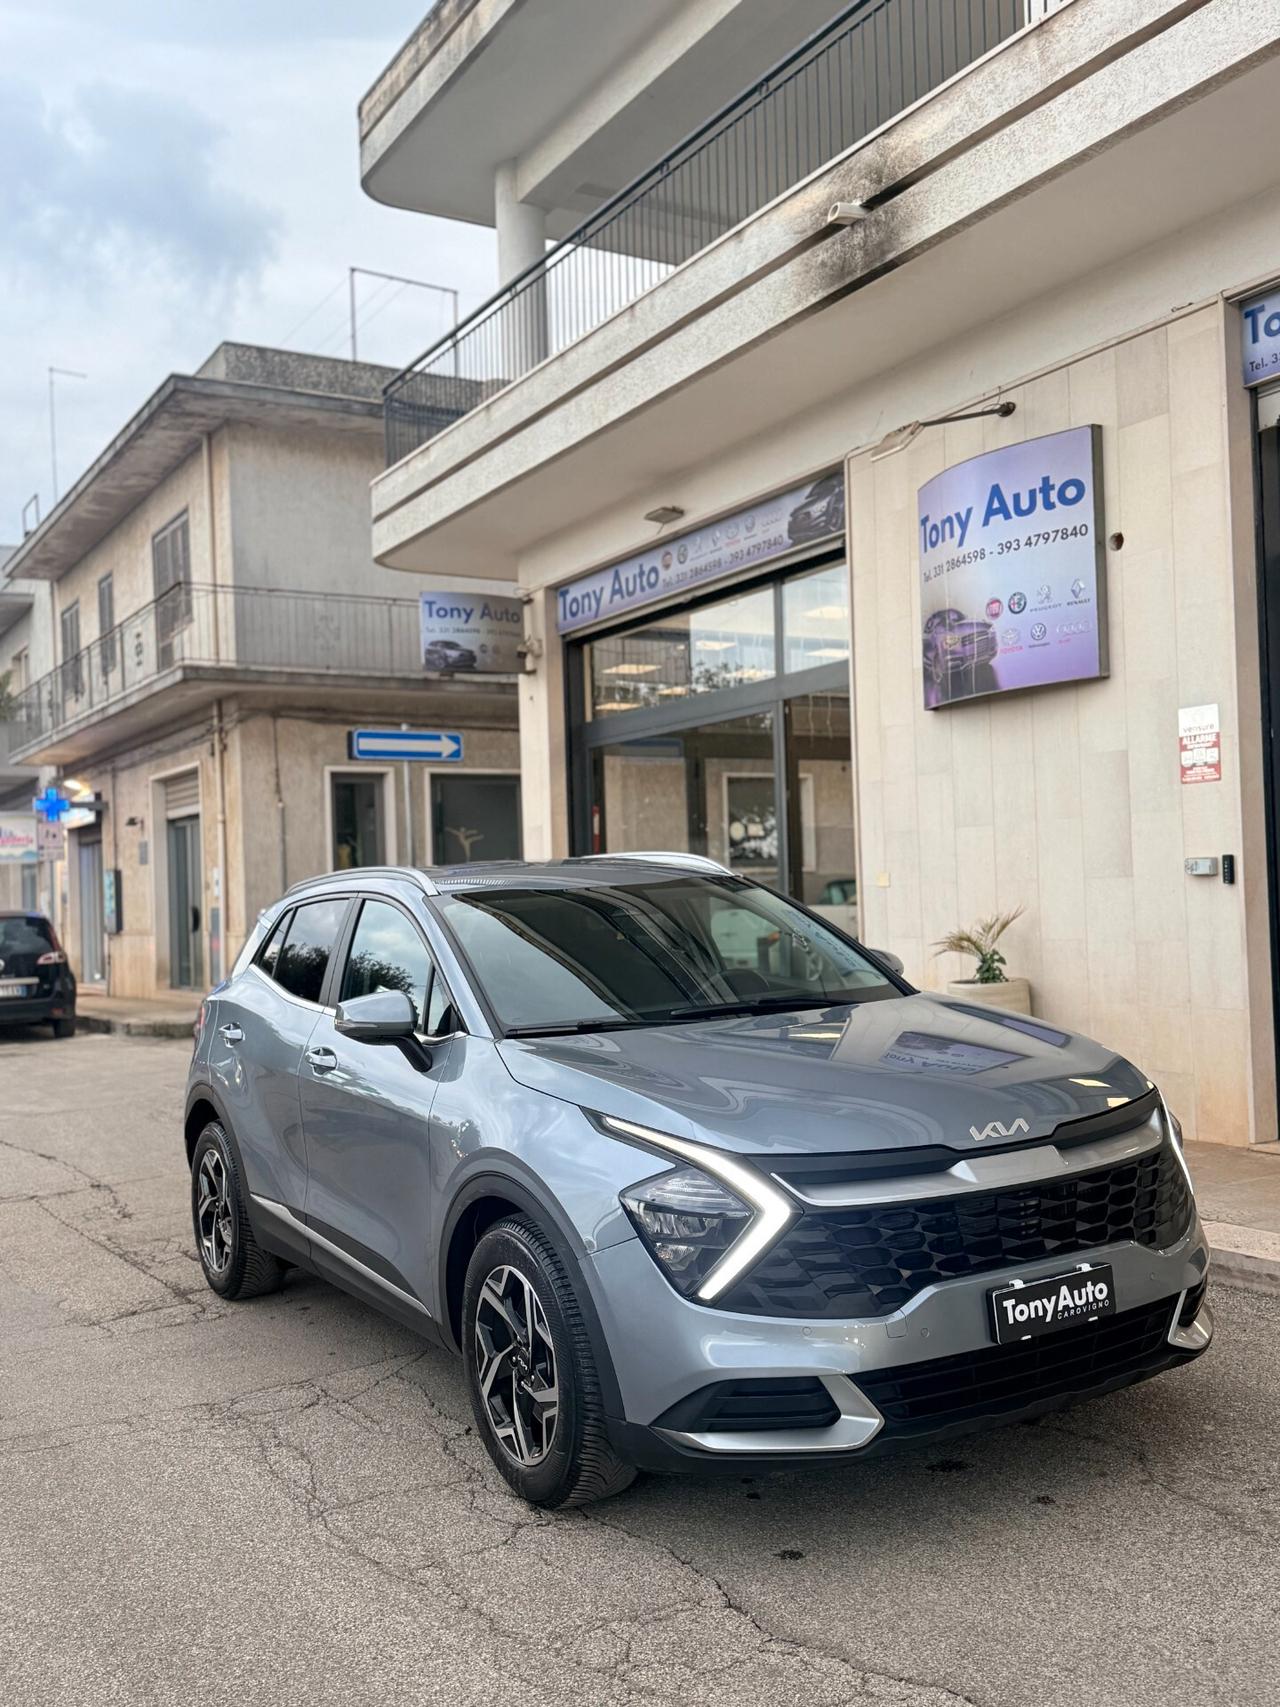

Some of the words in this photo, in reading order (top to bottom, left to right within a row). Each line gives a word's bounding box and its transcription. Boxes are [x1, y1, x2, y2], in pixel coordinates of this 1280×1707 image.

[1249, 358, 1268, 372] Tel.
[920, 506, 973, 553] Tony
[982, 475, 1086, 528] Auto
[945, 547, 986, 573] 2864598
[997, 538, 1021, 555] 393
[1024, 523, 1089, 547] 4797840
[559, 586, 604, 621] Tony
[609, 563, 660, 604] Auto
[424, 601, 474, 624] Tony
[480, 602, 521, 623] Auto
[970, 1118, 1030, 1141] KIA
[1057, 1299, 1109, 1319] CAROVIGNO
